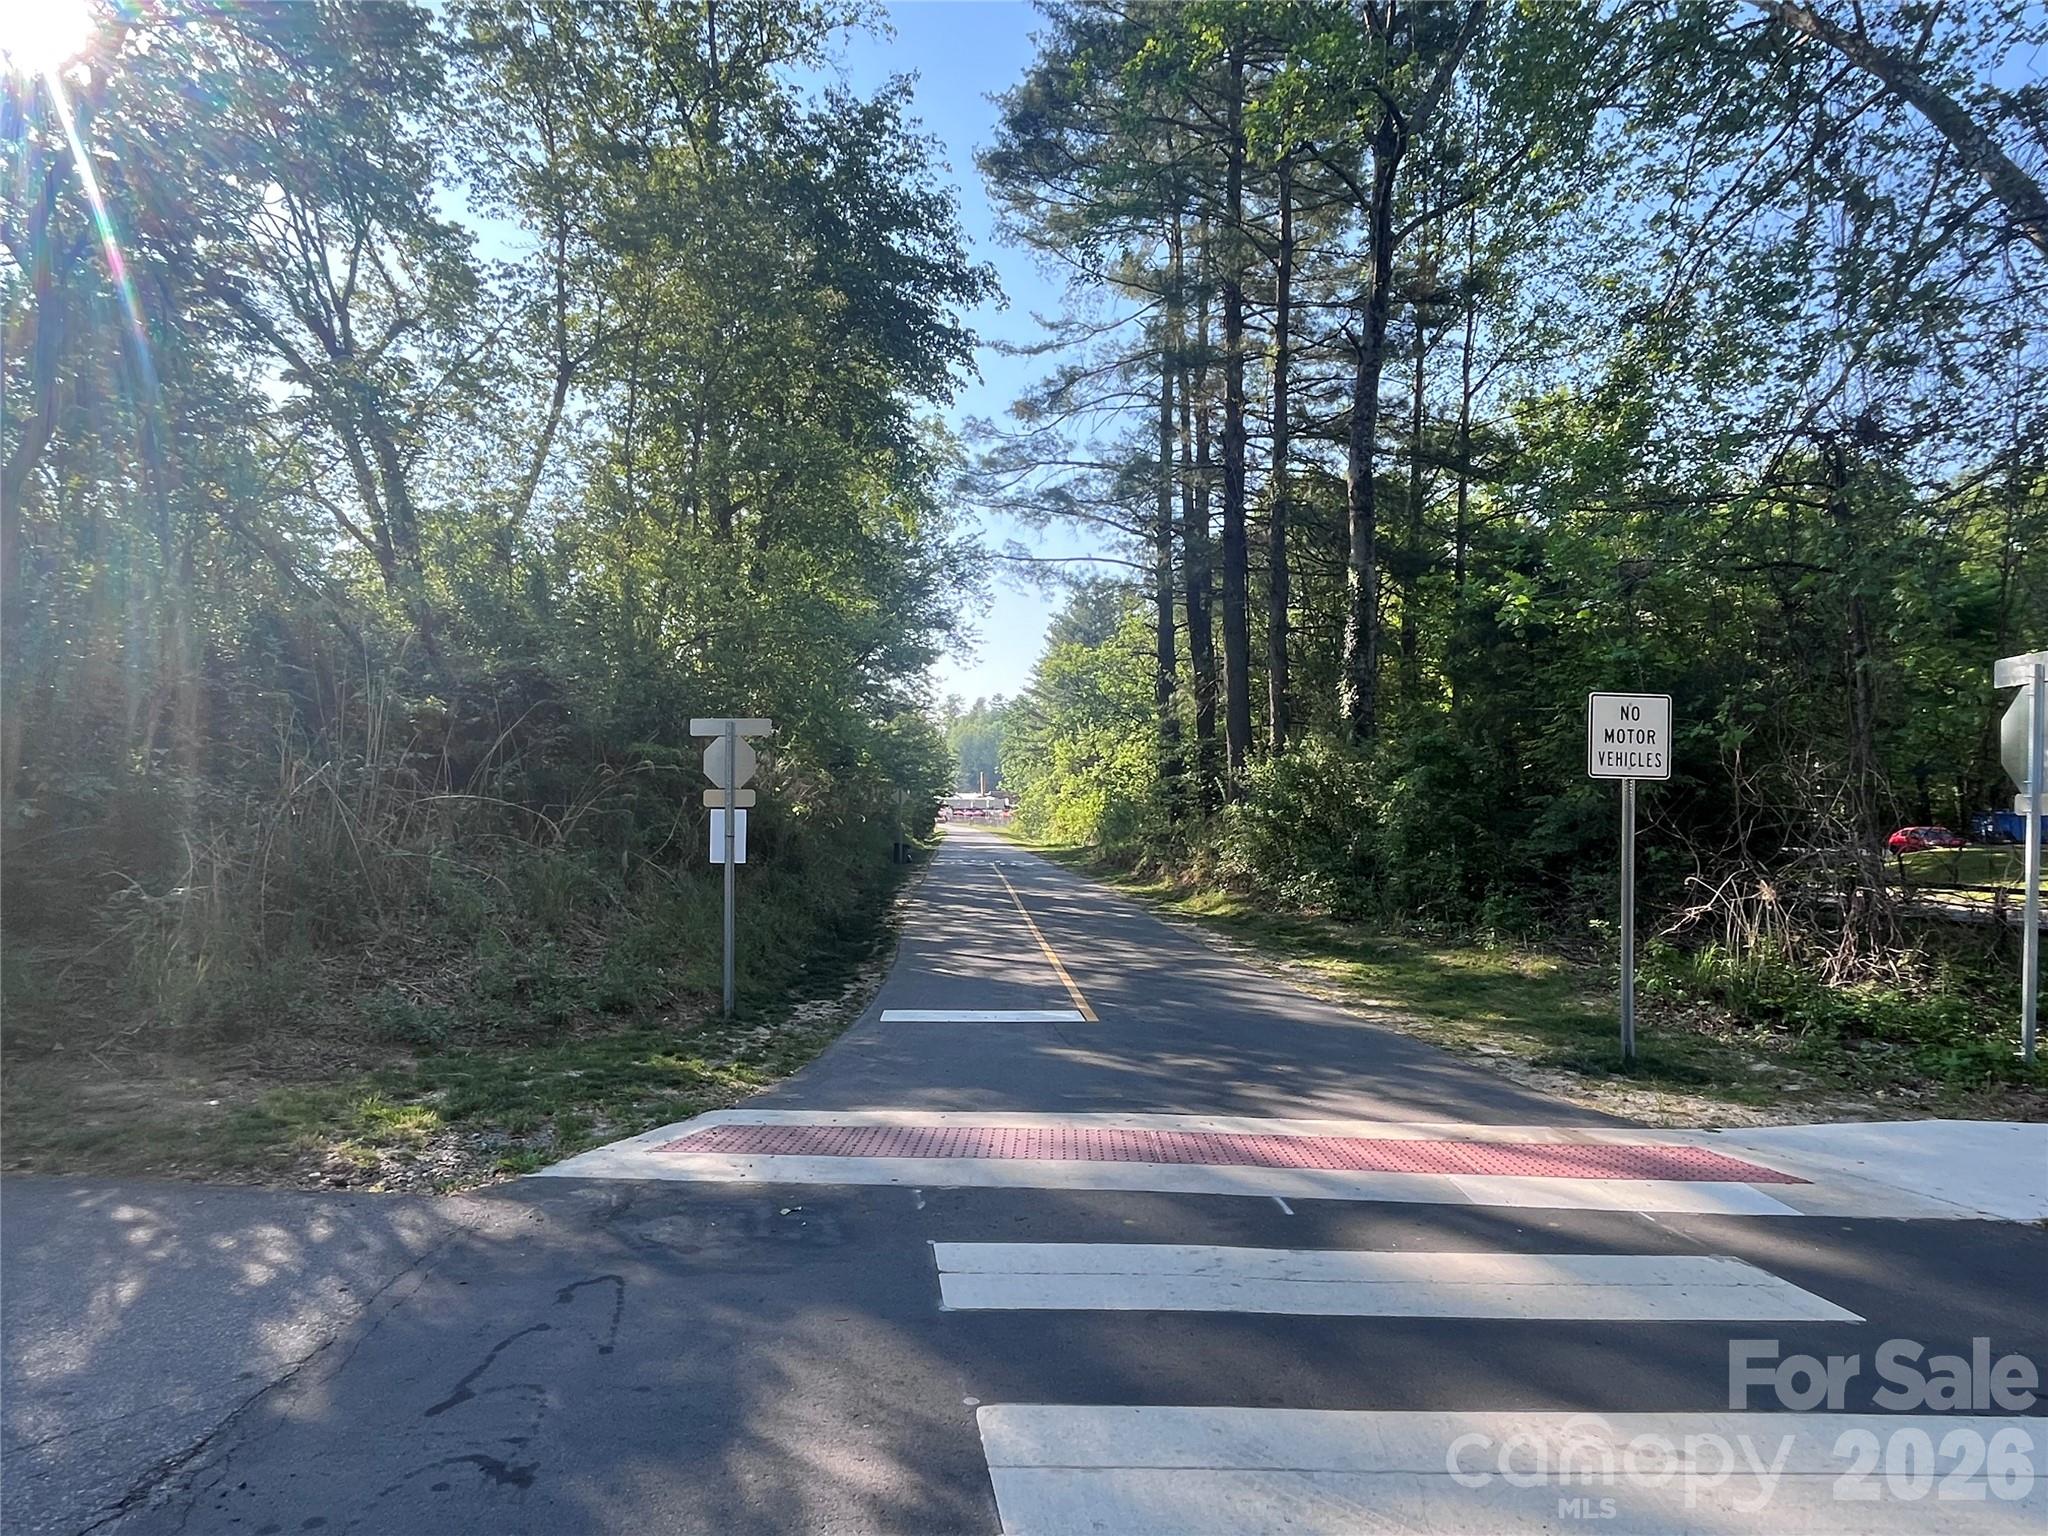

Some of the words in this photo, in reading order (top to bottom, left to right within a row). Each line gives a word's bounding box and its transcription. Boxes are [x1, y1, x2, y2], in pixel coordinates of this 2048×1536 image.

[1620, 705, 1640, 721] NO
[1604, 728, 1656, 744] MOTOR
[1598, 751, 1662, 768] VEHICLES
